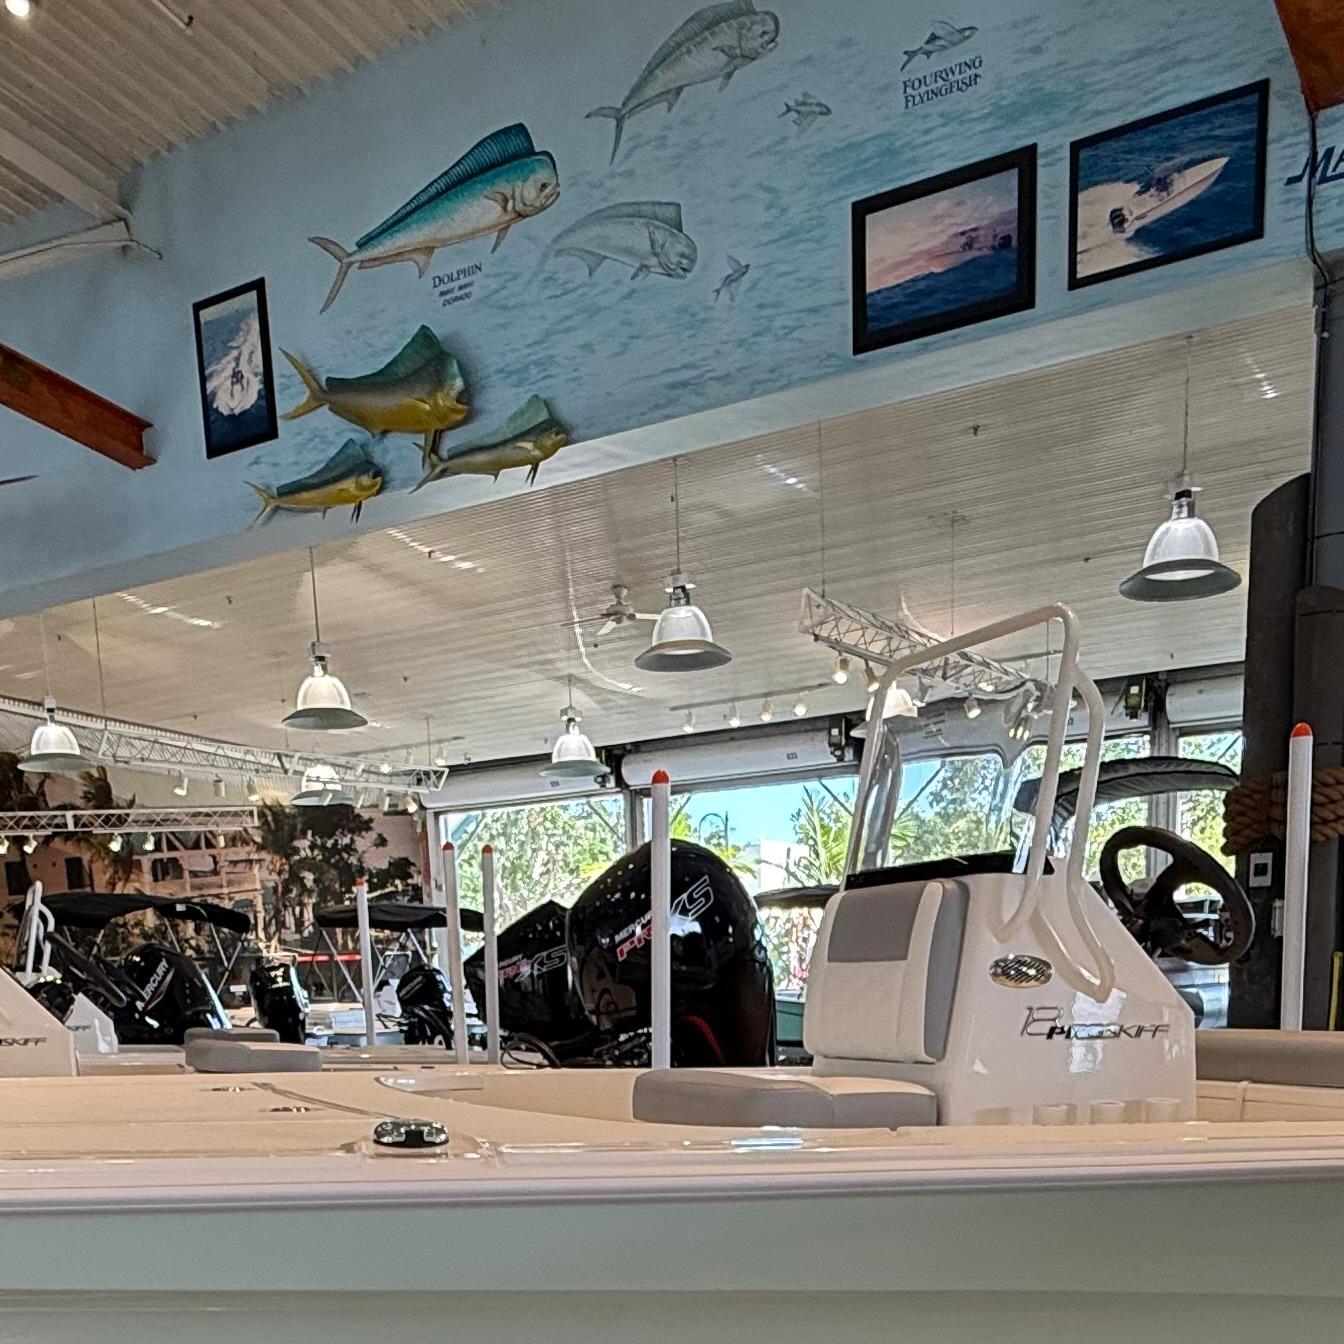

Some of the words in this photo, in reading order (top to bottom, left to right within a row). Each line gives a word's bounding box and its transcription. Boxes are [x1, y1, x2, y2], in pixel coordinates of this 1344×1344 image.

[902, 55, 984, 95] FOURWING
[903, 73, 982, 110] FLYINGFISH
[432, 262, 483, 289] DOLPHIN
